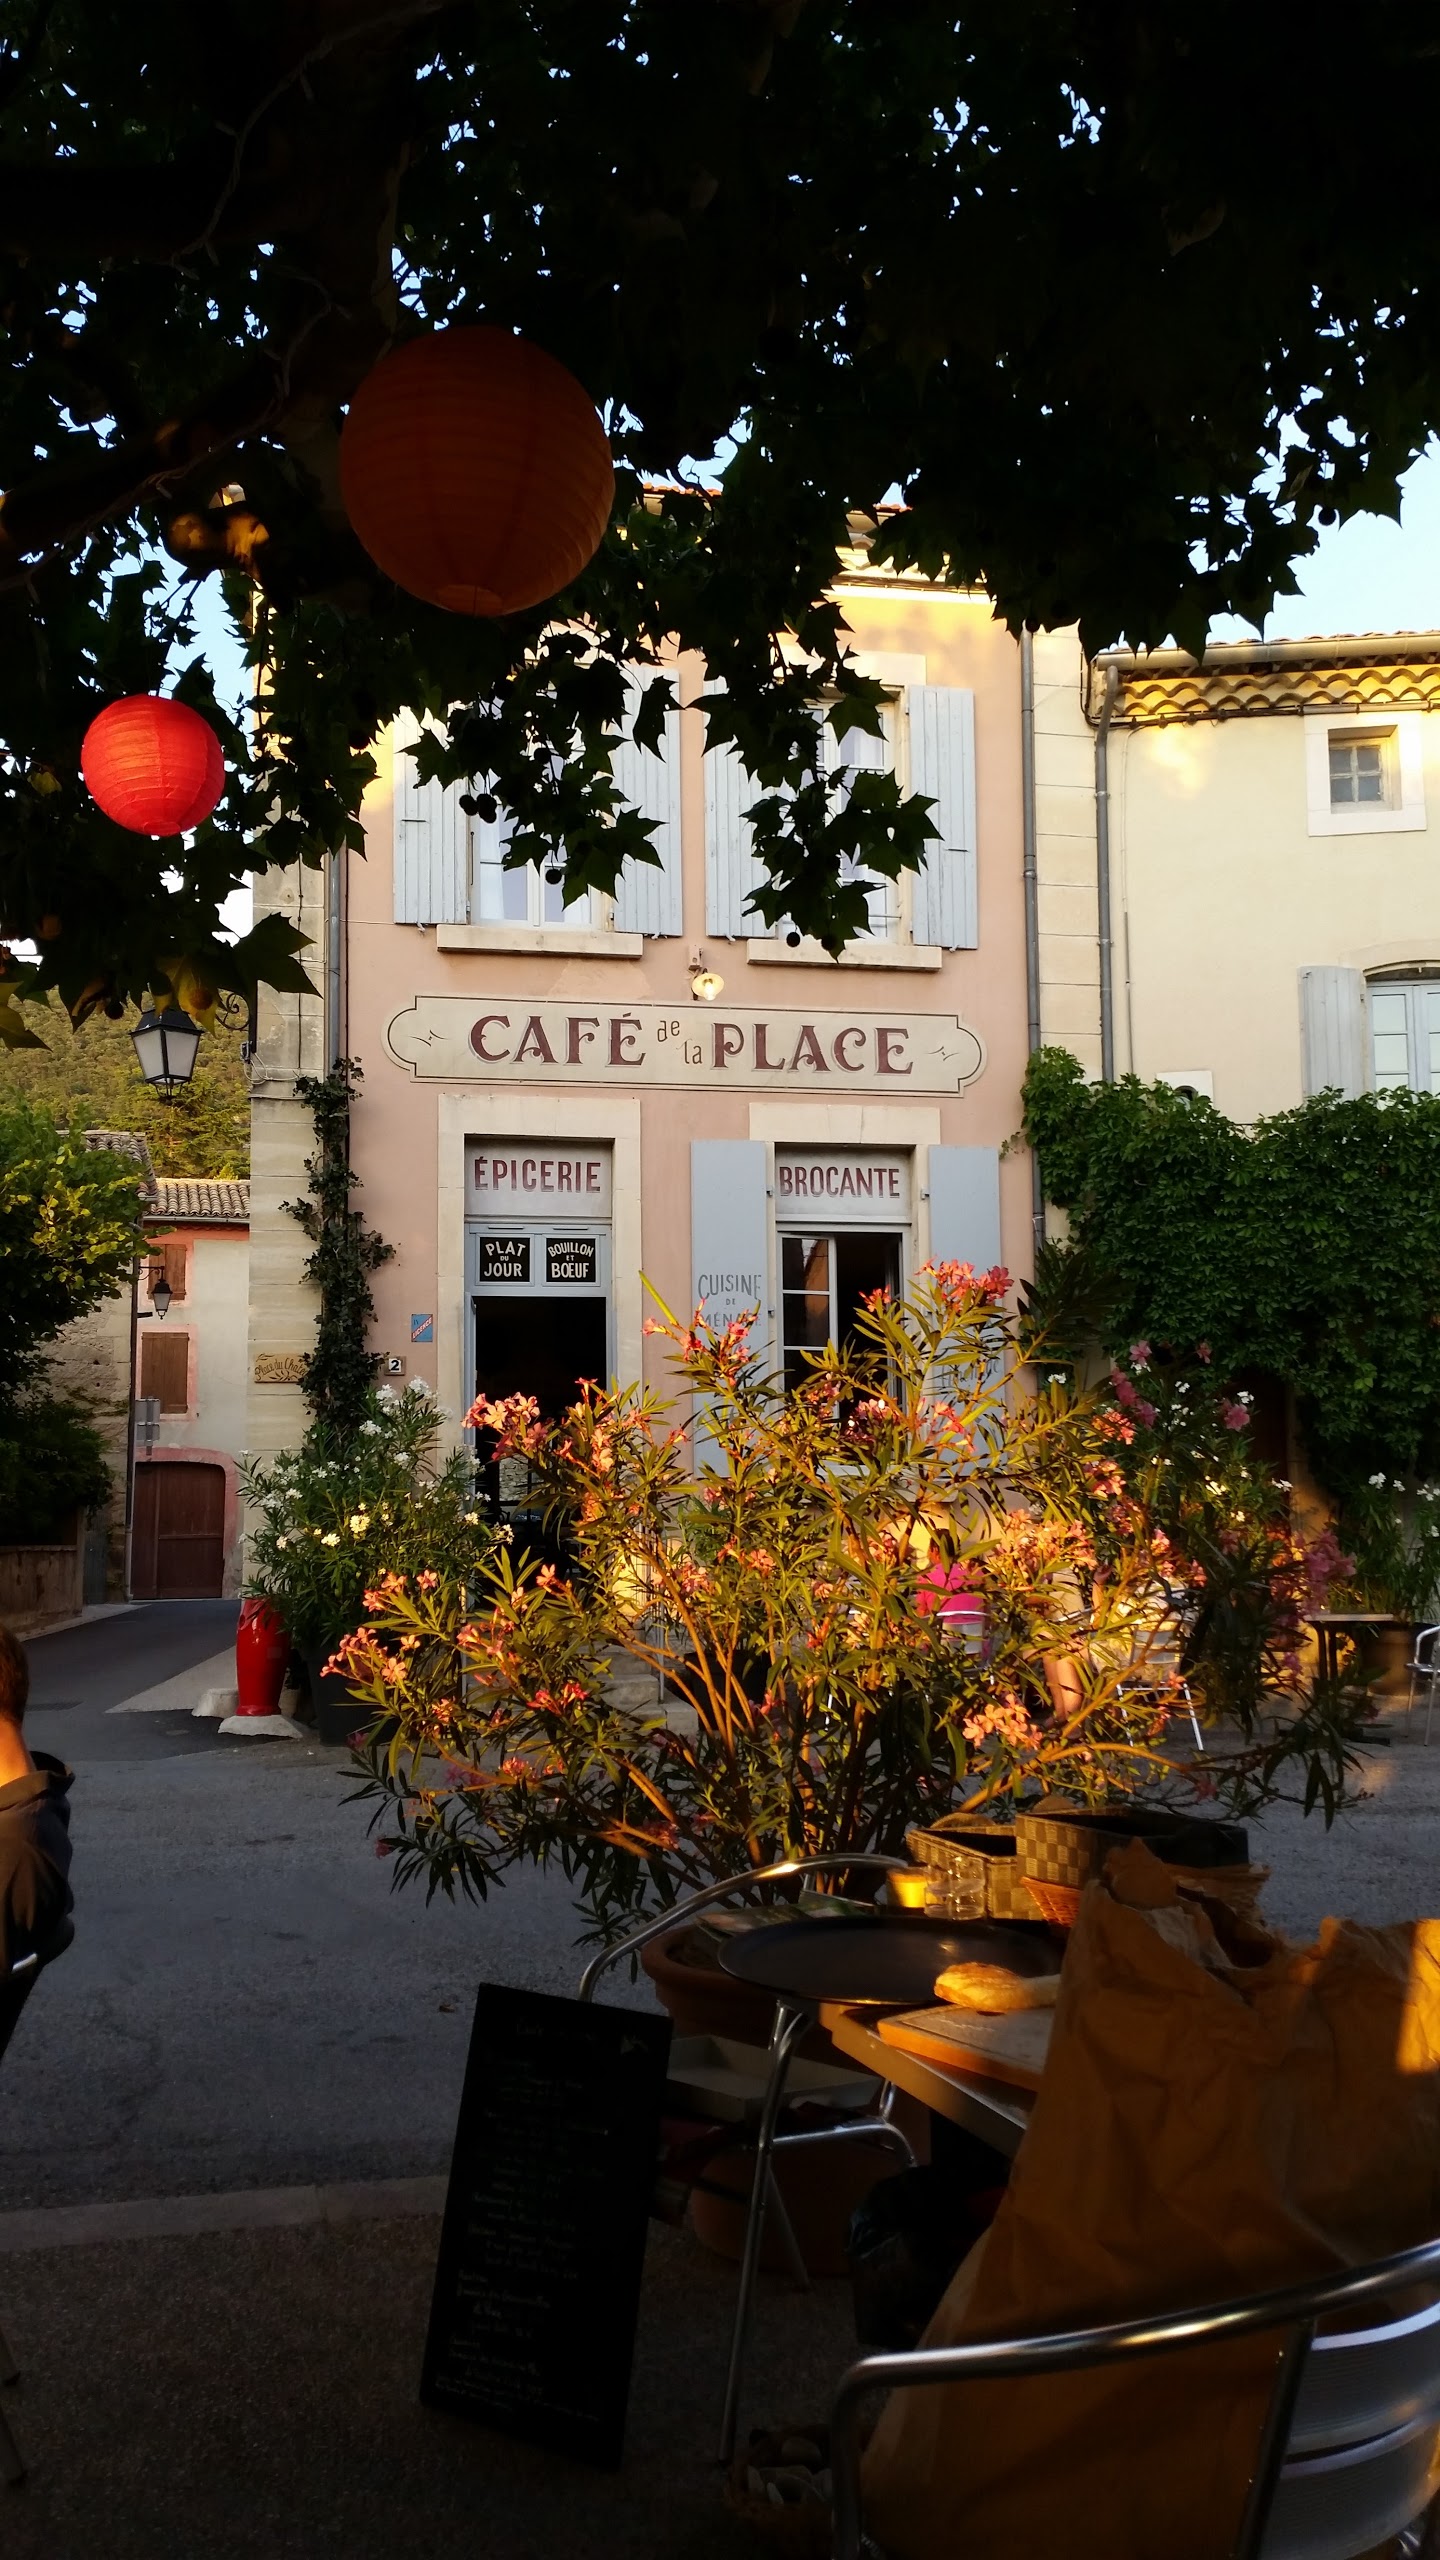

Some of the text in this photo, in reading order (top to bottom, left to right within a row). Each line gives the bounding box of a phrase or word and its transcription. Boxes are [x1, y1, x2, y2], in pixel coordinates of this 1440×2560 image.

[468, 1012, 914, 1075] CAFÉ de la PLACE
[474, 1156, 601, 1193] ÉPICERIE
[779, 1166, 900, 1198] BROCANTE
[485, 1241, 526, 1257] PLAT
[547, 1241, 595, 1258] BOUILLON
[483, 1262, 523, 1278] JOUR
[698, 1274, 762, 1300] CUISINE
[725, 1298, 736, 1306] DE
[412, 1316, 433, 1340] LICENCE
[390, 1359, 400, 1371] 2
